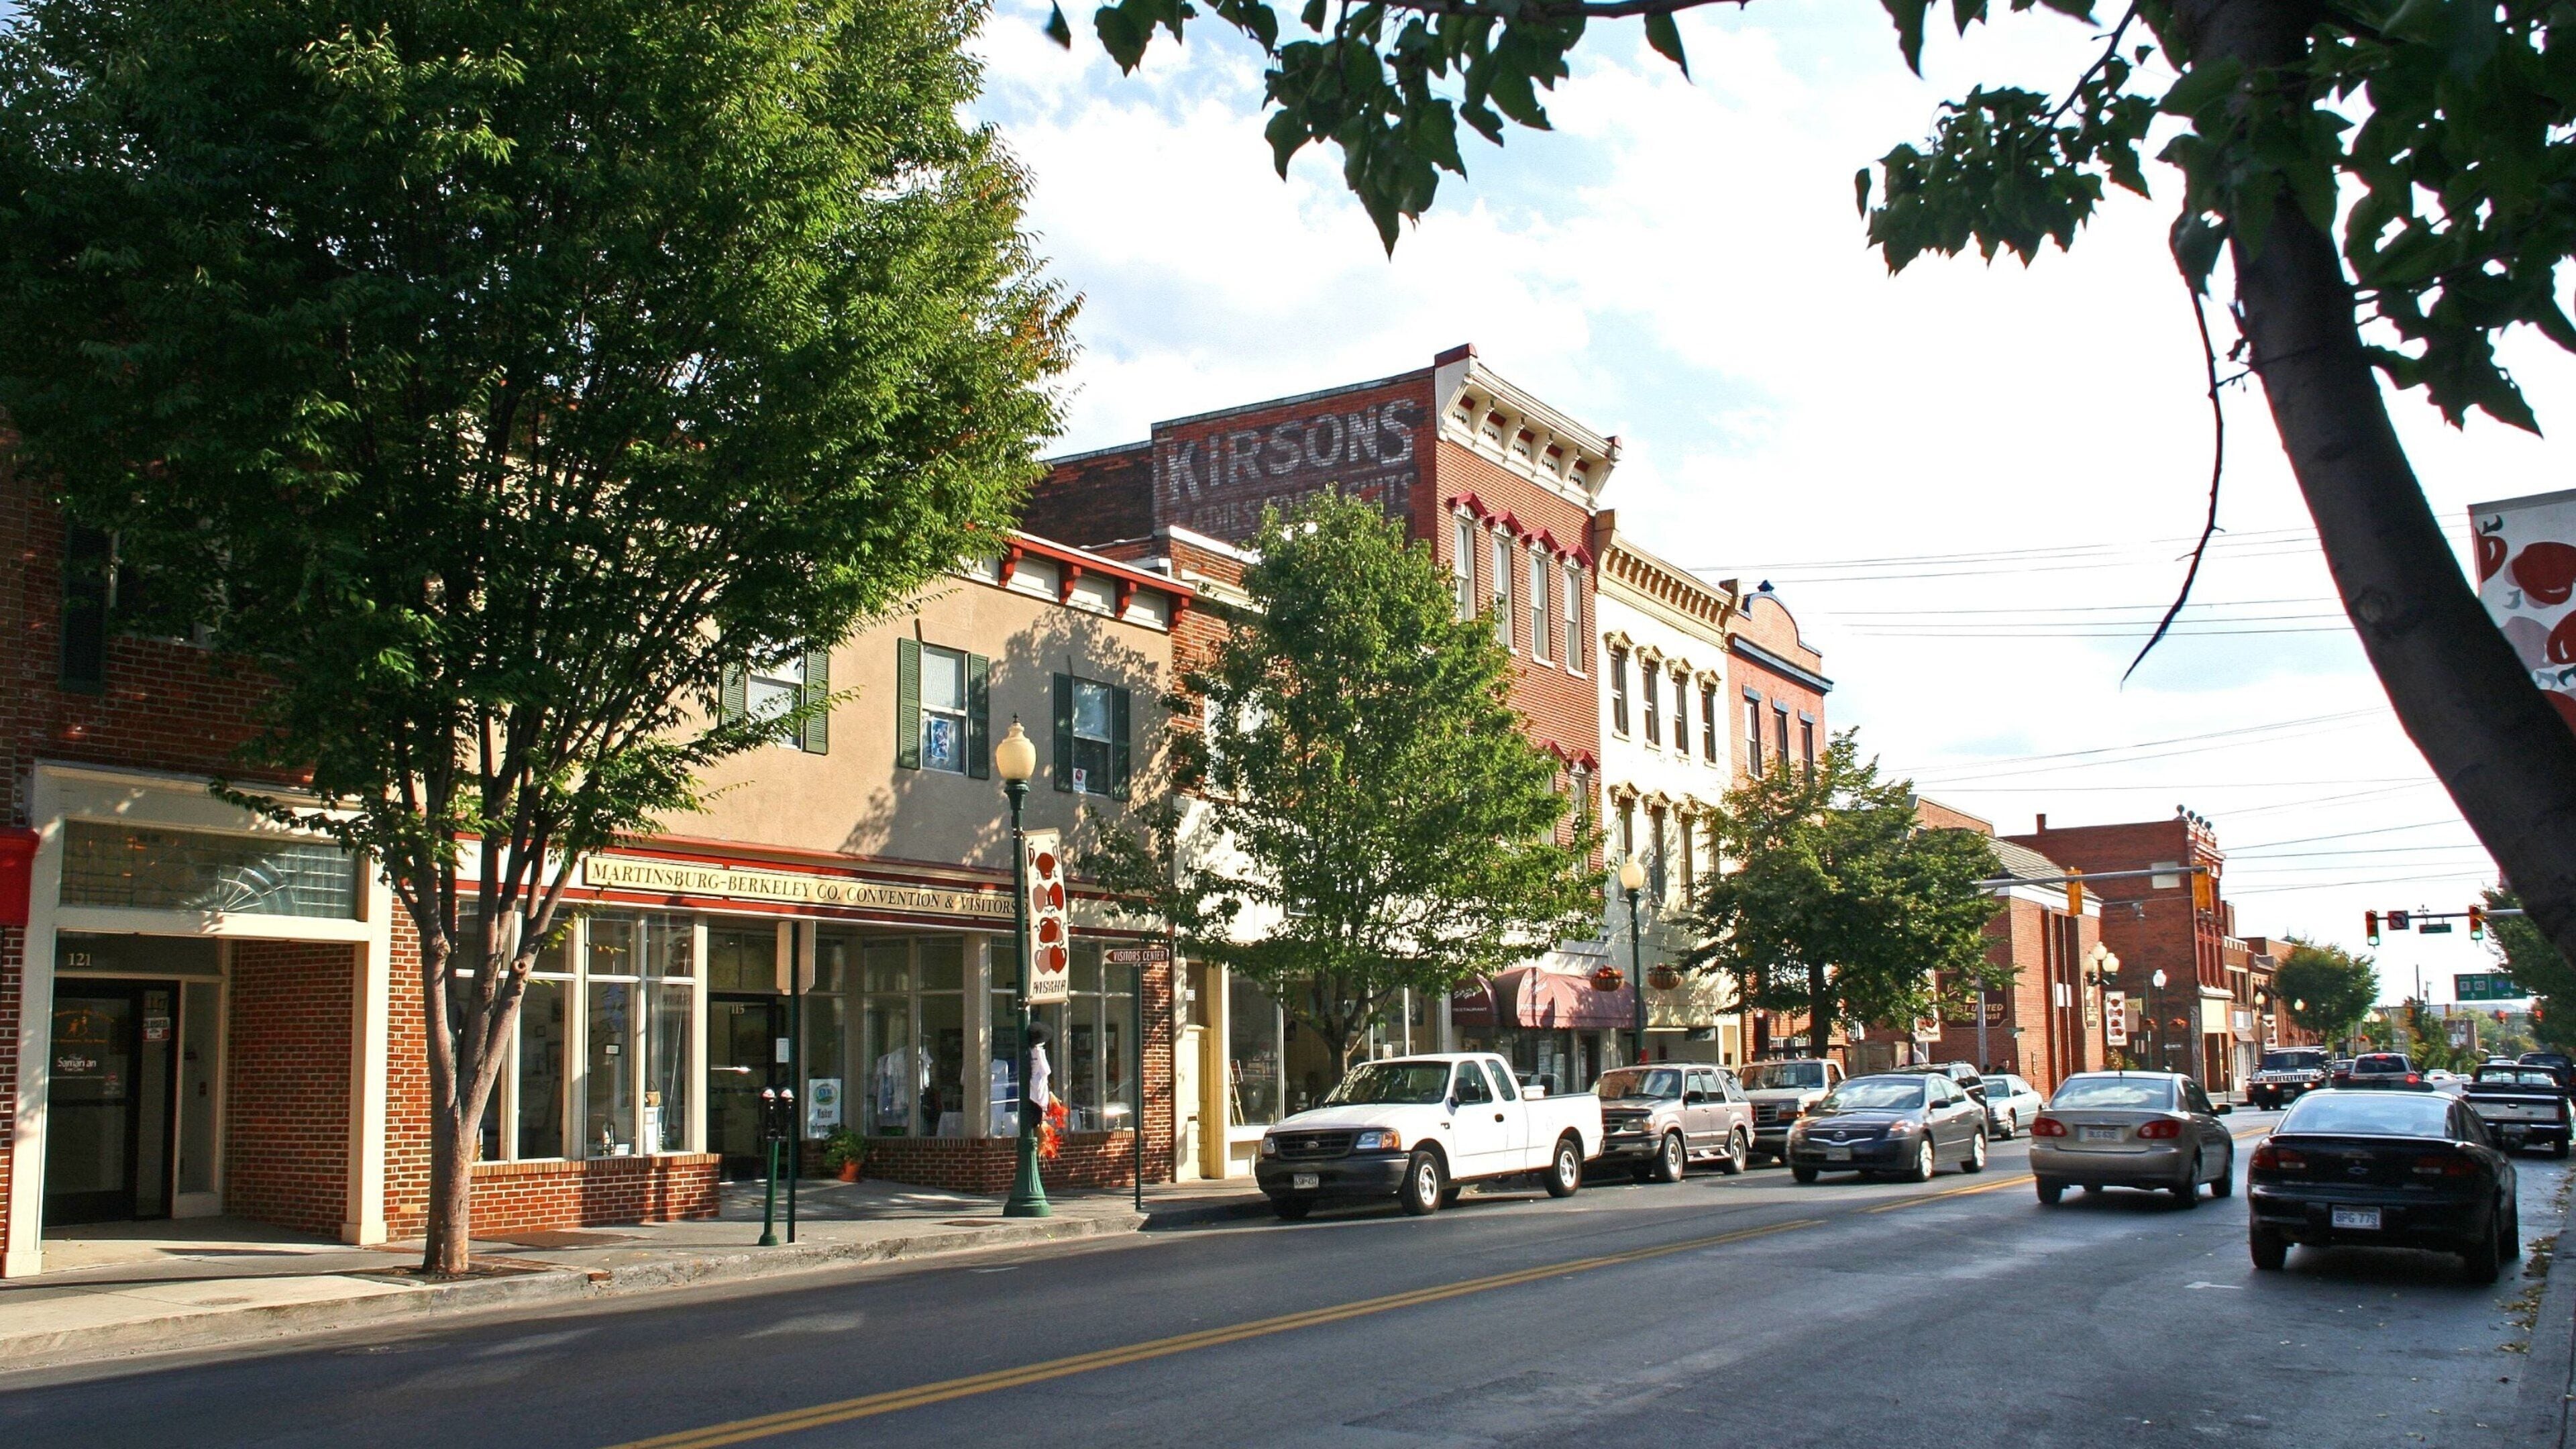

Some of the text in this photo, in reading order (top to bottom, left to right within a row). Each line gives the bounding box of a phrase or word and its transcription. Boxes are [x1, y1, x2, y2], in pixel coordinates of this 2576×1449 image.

[1167, 398, 1415, 504] KIRSONS
[592, 863, 812, 897] MARTINSBURG-BERKELEY
[817, 883, 841, 900] CO.
[847, 885, 940, 908] CONVENTION
[945, 896, 954, 908] &
[960, 896, 1015, 914] VISITORS
[68, 953, 92, 967] 121
[1113, 950, 1165, 961] VISITORS CENTER
[731, 1004, 745, 1014] 115
[1971, 1004, 2004, 1012] UTED
